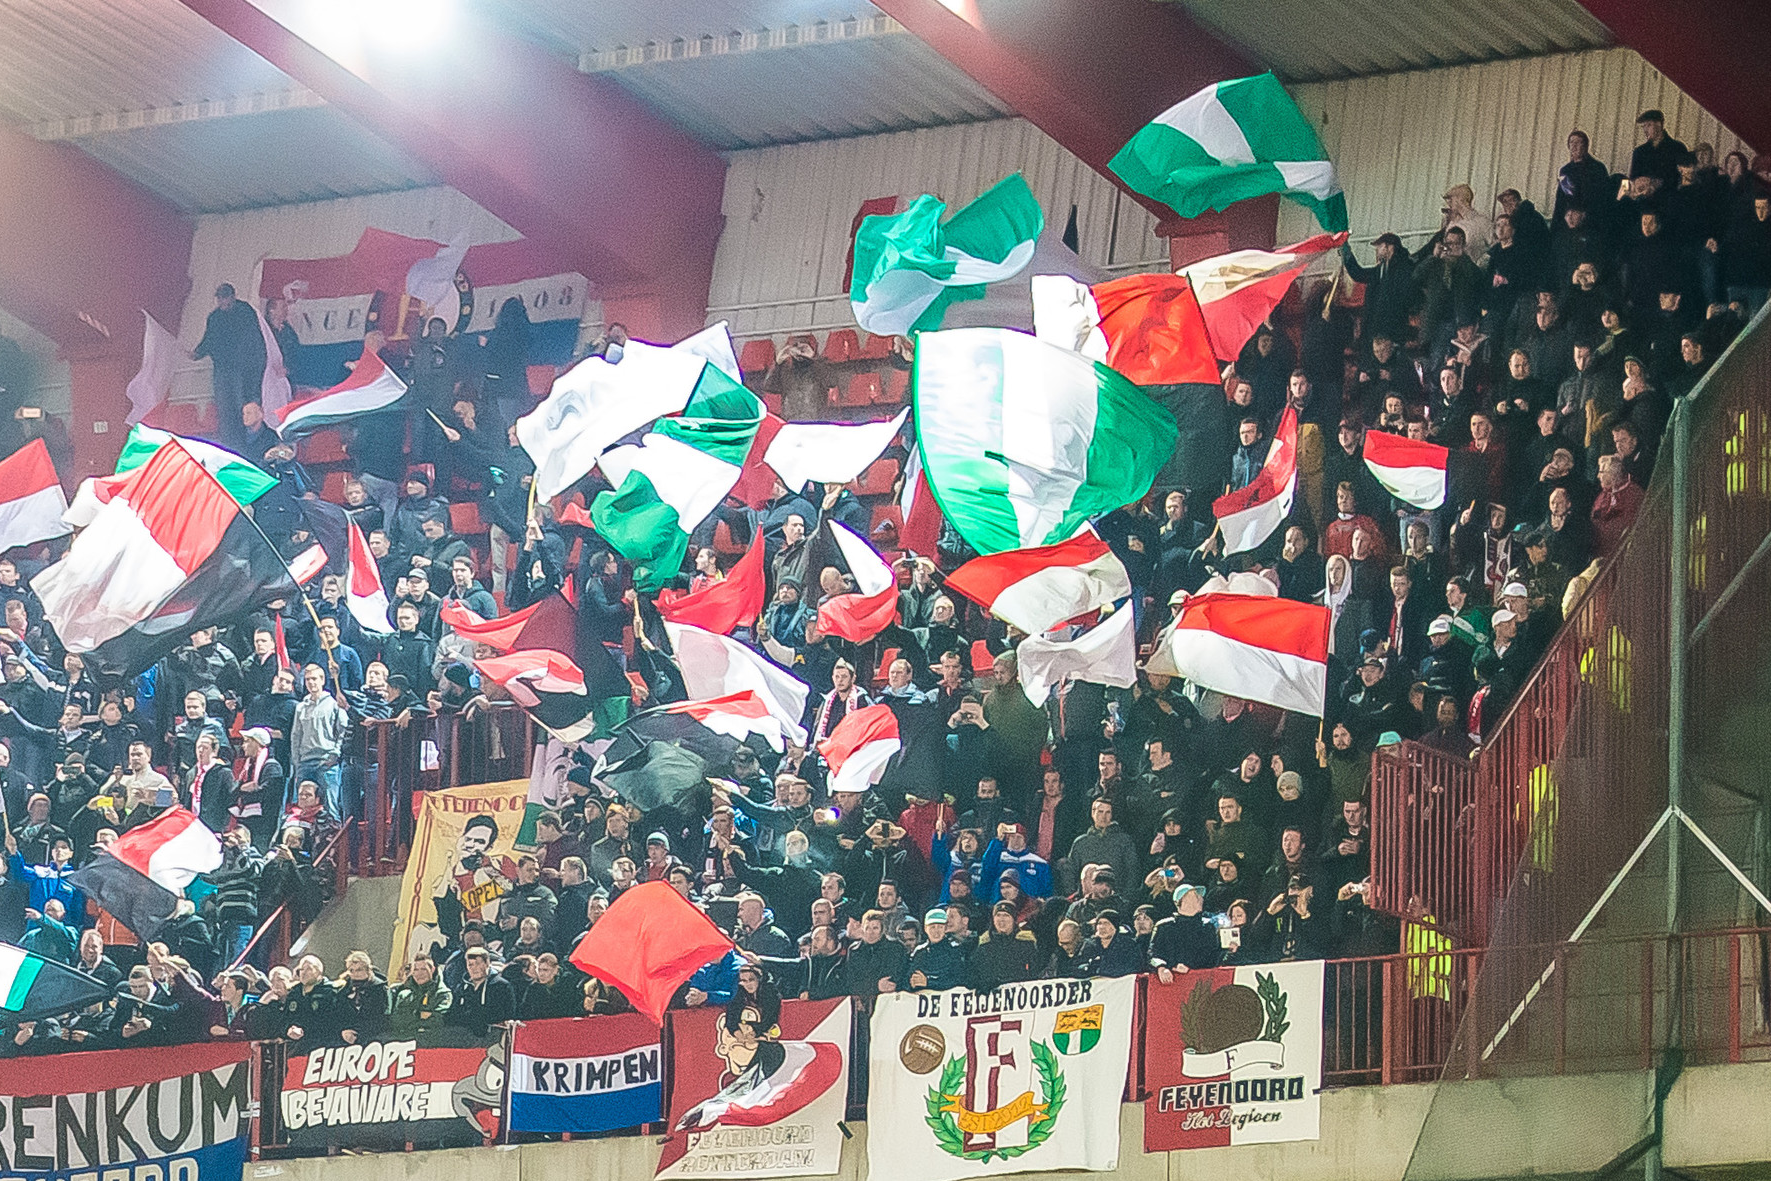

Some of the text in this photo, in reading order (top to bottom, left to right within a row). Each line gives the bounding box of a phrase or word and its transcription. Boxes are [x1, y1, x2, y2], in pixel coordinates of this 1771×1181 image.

[487, 286, 574, 318] 108
[917, 979, 1093, 1018] DE FEIJENOORDER
[302, 1040, 417, 1086] EUROPE
[533, 1050, 659, 1093] KRIMPEN
[1224, 1048, 1238, 1071] F
[1159, 1075, 1305, 1112] FEYENOORD
